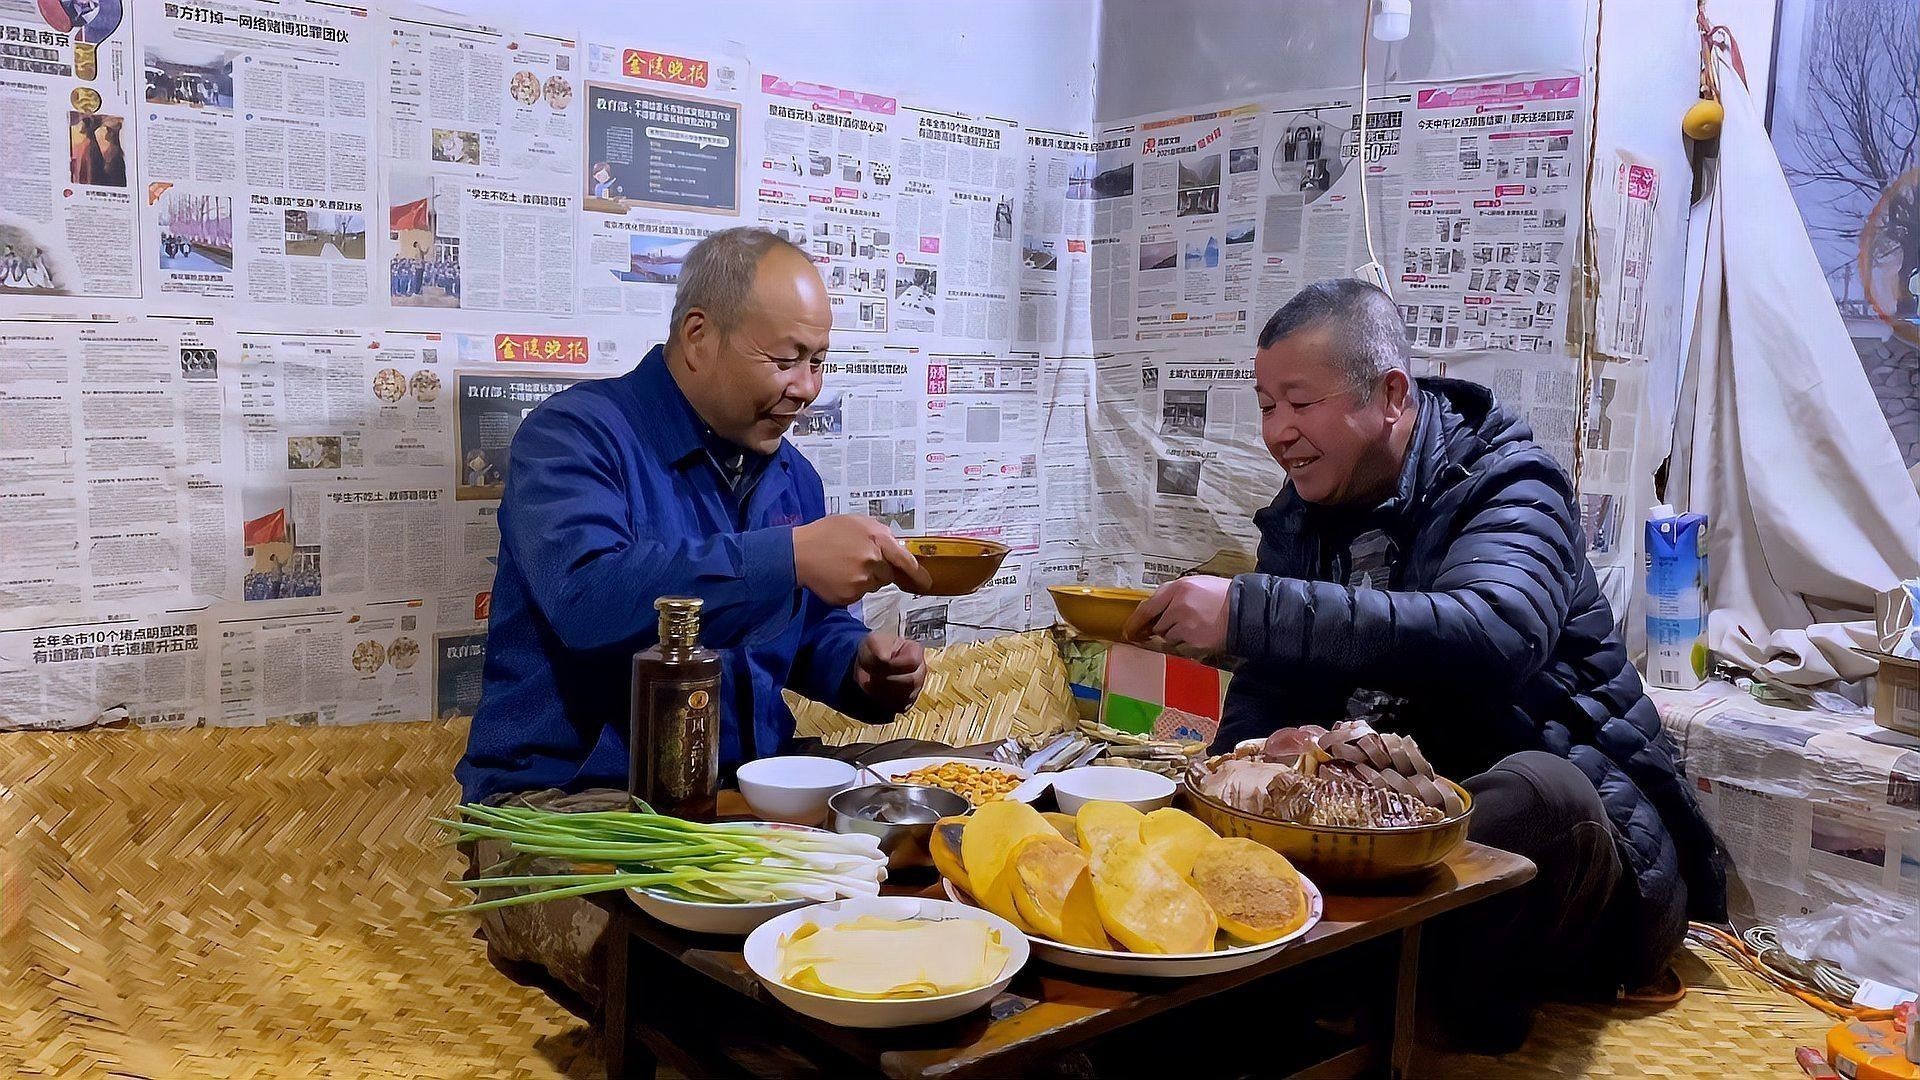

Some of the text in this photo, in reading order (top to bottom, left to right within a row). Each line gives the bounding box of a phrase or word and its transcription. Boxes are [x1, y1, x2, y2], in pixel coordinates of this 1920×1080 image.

[165, 3, 349, 43] 警方打掉一网络赌博犯罪团伙
[625, 51, 706, 84] 金陵晚报
[497, 336, 587, 361] 金陵晚报
[32, 623, 198, 649] 去年全市10个堵点明显改善
[32, 637, 199, 664] 有道路高峰车速提升五成
